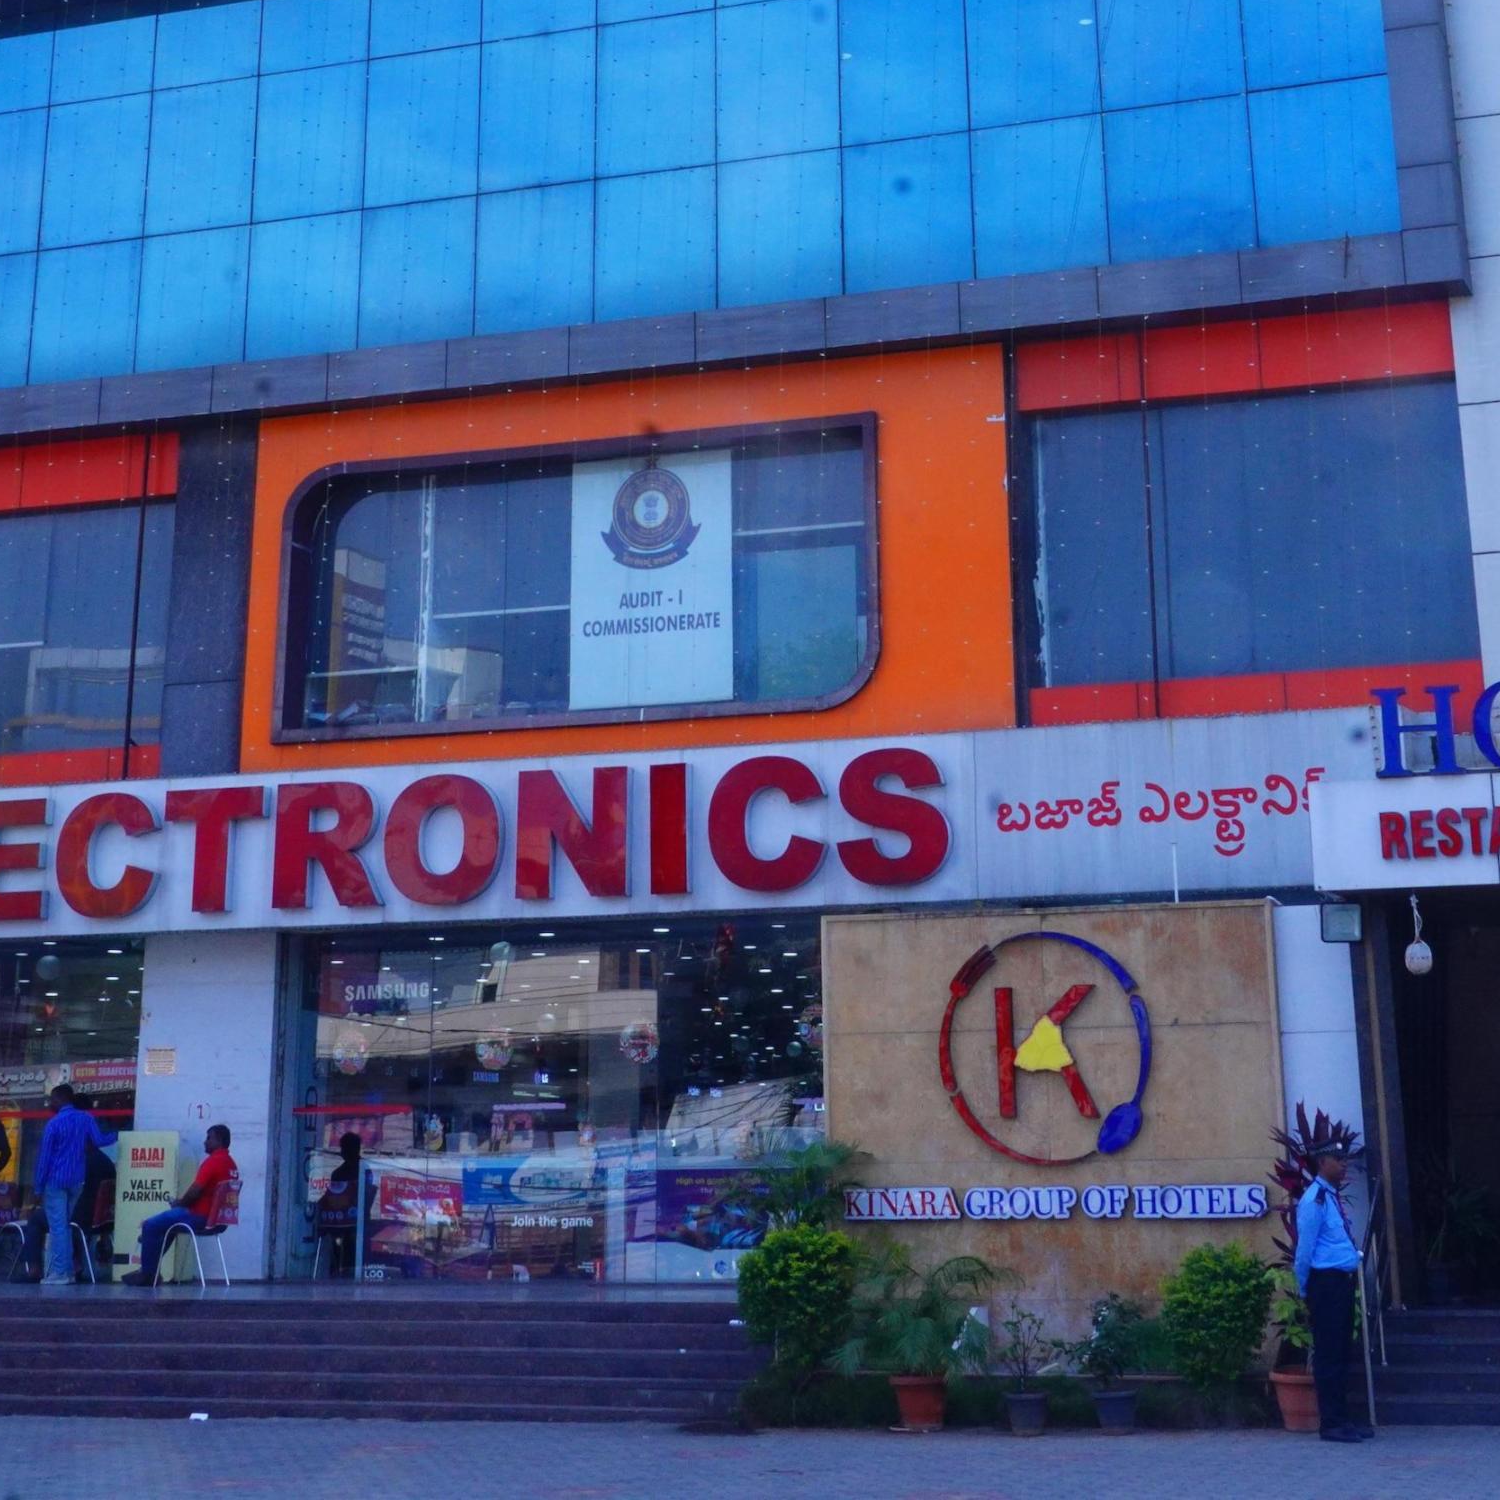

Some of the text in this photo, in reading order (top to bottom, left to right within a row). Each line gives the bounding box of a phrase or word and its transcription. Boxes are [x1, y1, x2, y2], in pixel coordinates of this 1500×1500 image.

[619, 591, 664, 609] AUDIT
[582, 611, 721, 637] COMMISSIONERATE
[995, 780, 1122, 832] బజాజ్
[344, 981, 430, 1001] SAMSUNG
[131, 1148, 165, 1162] BAJAJ
[130, 1179, 164, 1190] VALET
[122, 1191, 170, 1203] PARKING
[845, 1185, 1268, 1219] KINARA GROUP OF HOTELS
[510, 1214, 594, 1230] Join the game
